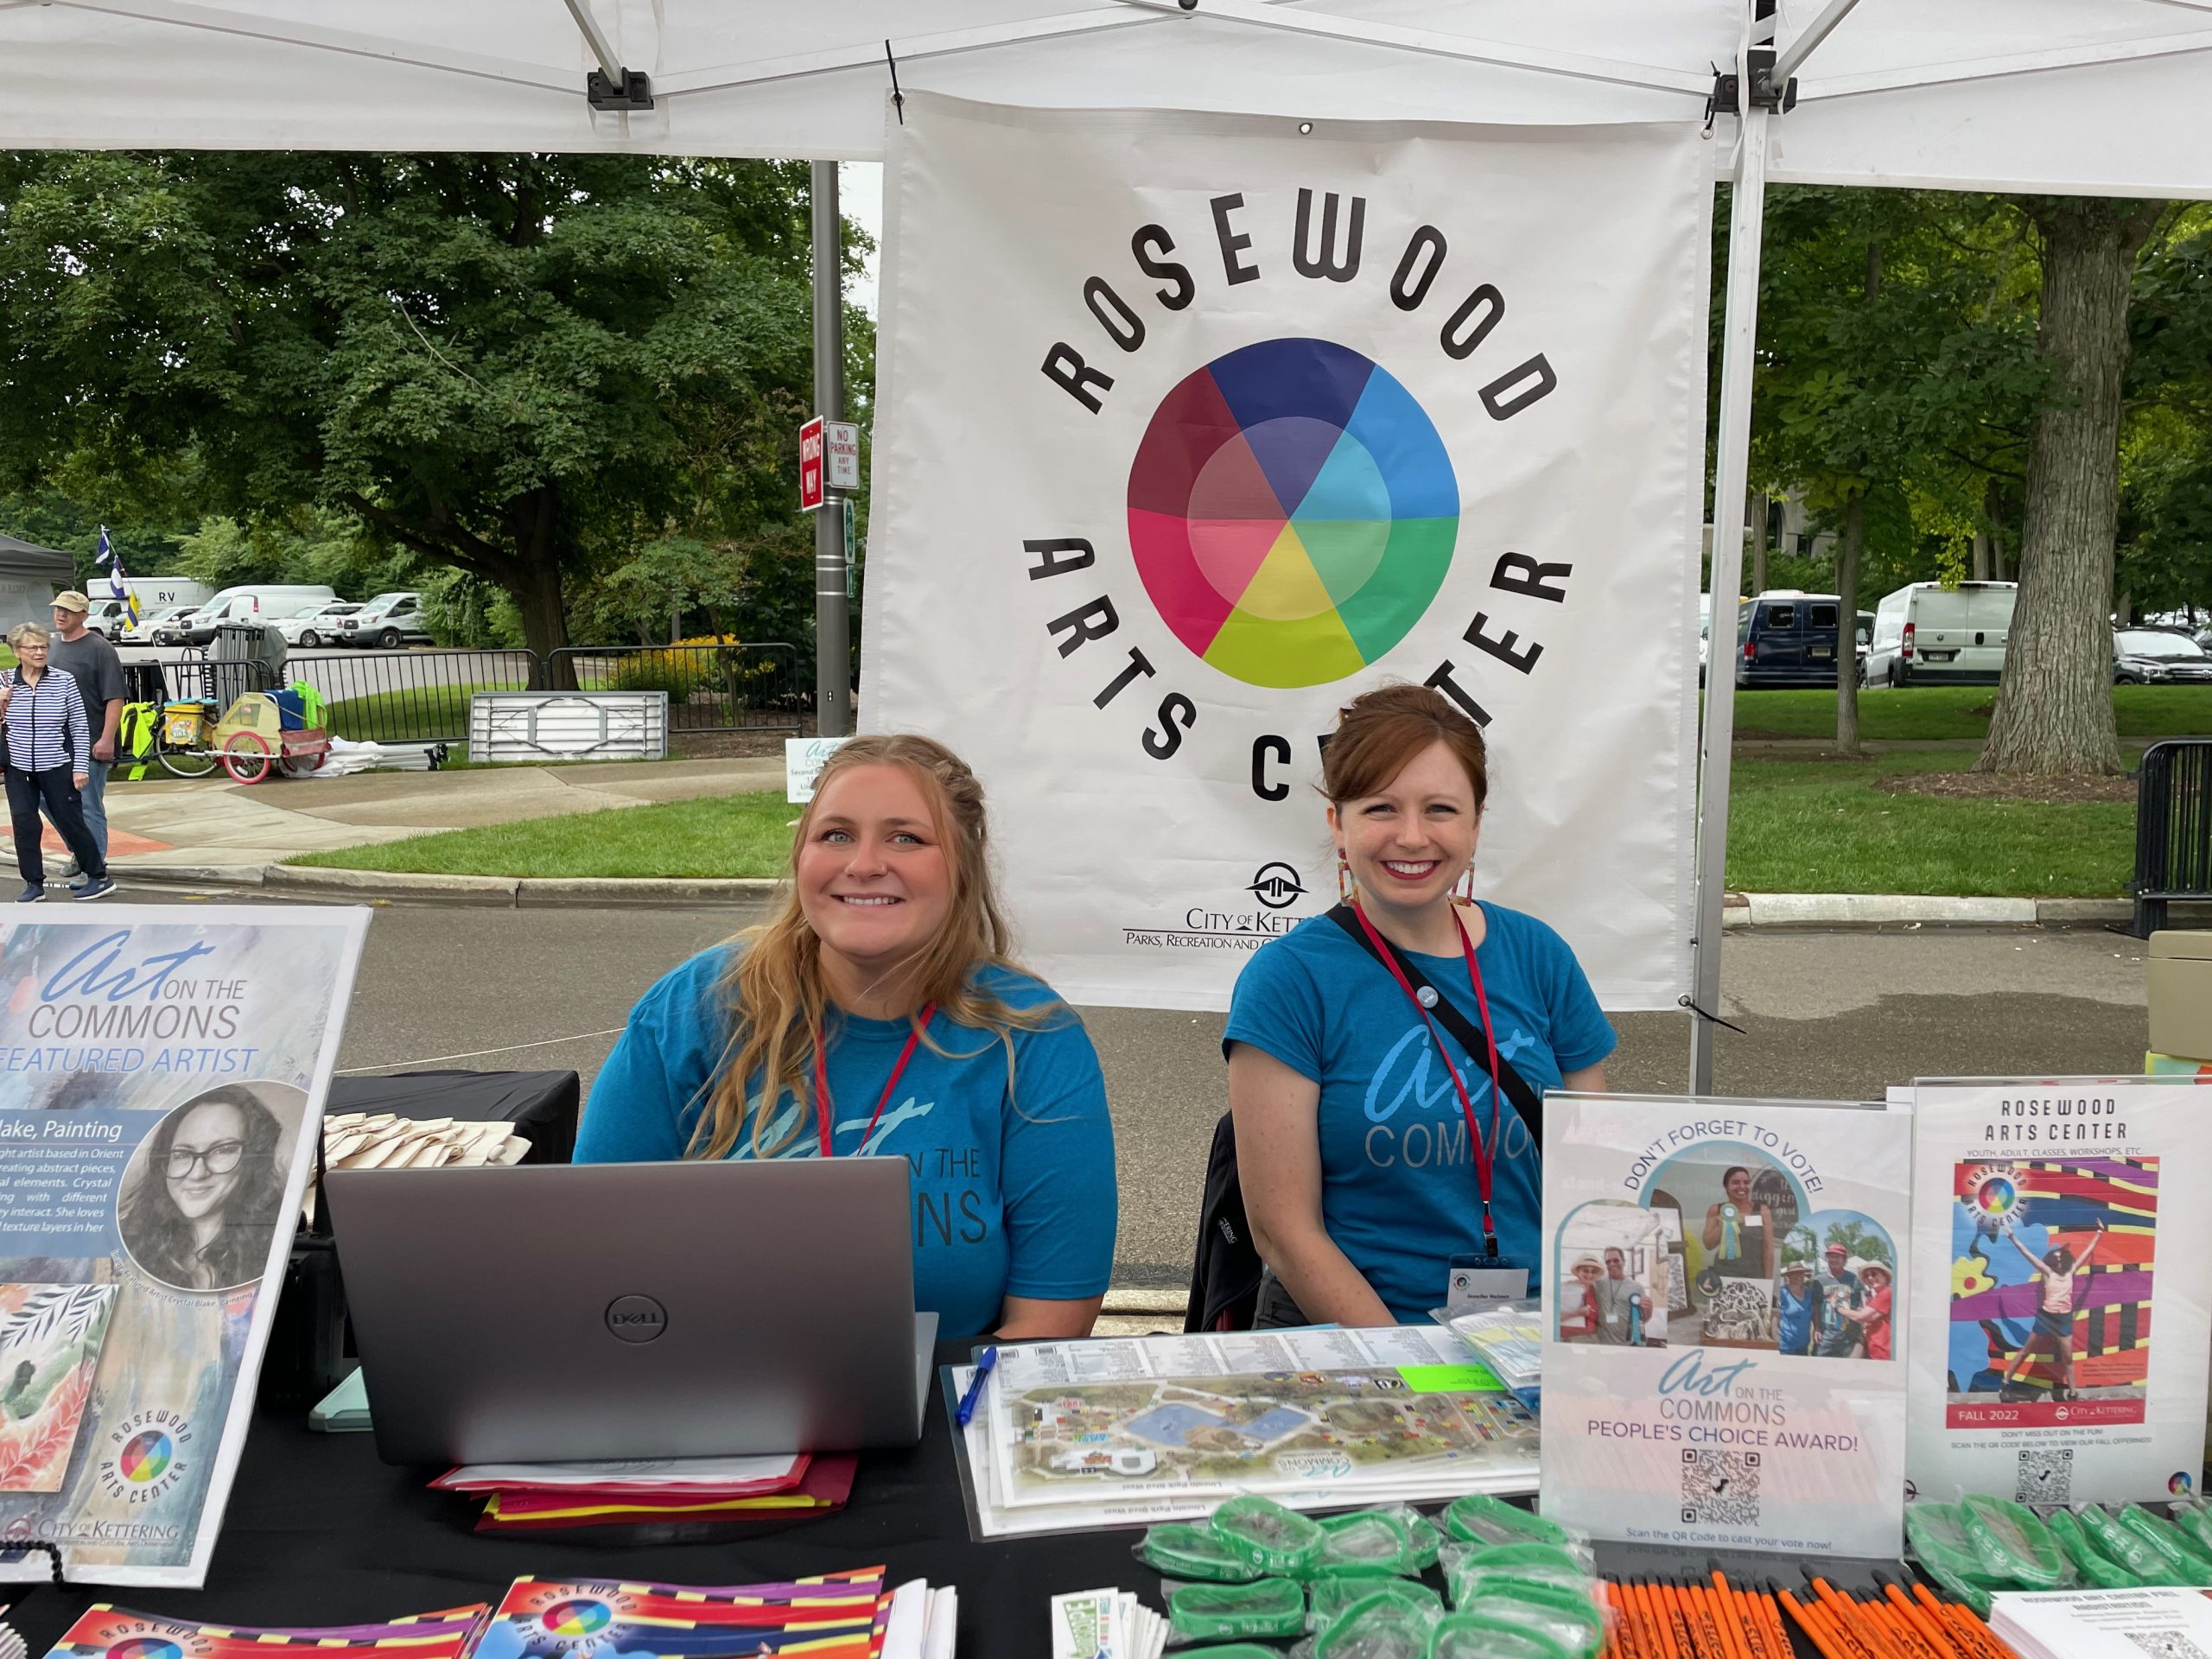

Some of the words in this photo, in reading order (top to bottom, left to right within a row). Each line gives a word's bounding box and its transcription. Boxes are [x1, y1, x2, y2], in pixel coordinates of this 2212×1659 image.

[1040, 188, 1557, 421] ROSEWOOD
[802, 432, 821, 463] WRONG
[836, 429, 849, 442] NO
[830, 442, 856, 456] PARKING
[838, 456, 850, 466] ANY
[805, 468, 817, 495] WAY
[837, 465, 852, 475] TIME
[158, 592, 175, 602] RV
[1023, 537, 1197, 760] ARTS
[1251, 551, 1573, 802] CTER
[41, 929, 217, 1002] Art
[163, 979, 196, 1001] ON
[206, 979, 249, 1001] THE
[28, 1004, 241, 1040] COMMONS
[150, 1047, 259, 1072] ARTIST
[2001, 1098, 2117, 1116] ROSEWOOD
[43, 1120, 123, 1143] Painting
[1985, 1124, 2038, 1142] ARTS
[2049, 1122, 2127, 1141] CENTER
[17, 1148, 46, 1159] artist
[46, 1147, 78, 1159] based
[79, 1149, 89, 1159] in
[91, 1148, 124, 1159] Orient
[934, 1148, 982, 1179] THE
[1624, 1139, 1668, 1191] DON'T
[1668, 1120, 1749, 1147] FORGET
[1753, 1125, 1779, 1148] TO
[1782, 1142, 1824, 1194] VOTE!
[36, 1163, 79, 1173] abstract
[80, 1164, 117, 1175] pieces,
[1967, 1163, 2027, 1187] ROSEWOOD
[14, 1177, 68, 1188] elements.
[73, 1178, 112, 1190] Crystal
[27, 1192, 51, 1203] with
[61, 1192, 108, 1203] different
[10, 1206, 53, 1217] interact.
[55, 1206, 75, 1217] She
[76, 1206, 105, 1217] loves
[3, 1222, 41, 1232] texture
[41, 1221, 73, 1235] layers
[73, 1222, 83, 1232] in
[85, 1222, 105, 1232] her
[612, 1312, 664, 1326] DELL
[1657, 1348, 1759, 1397] Art
[1735, 1386, 1755, 1401] ON
[1758, 1388, 1783, 1402] THE
[1659, 1397, 1786, 1427] COMMONS
[1958, 1410, 1986, 1422] FALL
[1989, 1409, 2019, 1421] 2022
[111, 1409, 193, 1443] ROSEWOOD
[1587, 1420, 1681, 1442] PEOPLE'S
[1688, 1426, 1769, 1446] CHOICE
[1774, 1433, 1859, 1452] AWARD!
[100, 1461, 125, 1499] ARTS
[129, 1462, 188, 1503] CENTER
[1626, 1527, 1650, 1539] Scan
[1652, 1529, 1669, 1540] the
[1671, 1530, 1688, 1542] QR
[1689, 1530, 1716, 1542] Code
[1718, 1534, 1729, 1543] to
[1731, 1535, 1752, 1545] cast
[1754, 1536, 1779, 1549] your
[1781, 1539, 1805, 1549] vote
[1806, 1541, 1833, 1551] now!
[531, 1584, 637, 1611] ROSEWOOD
[99, 1622, 213, 1654] ROSEWOOD
